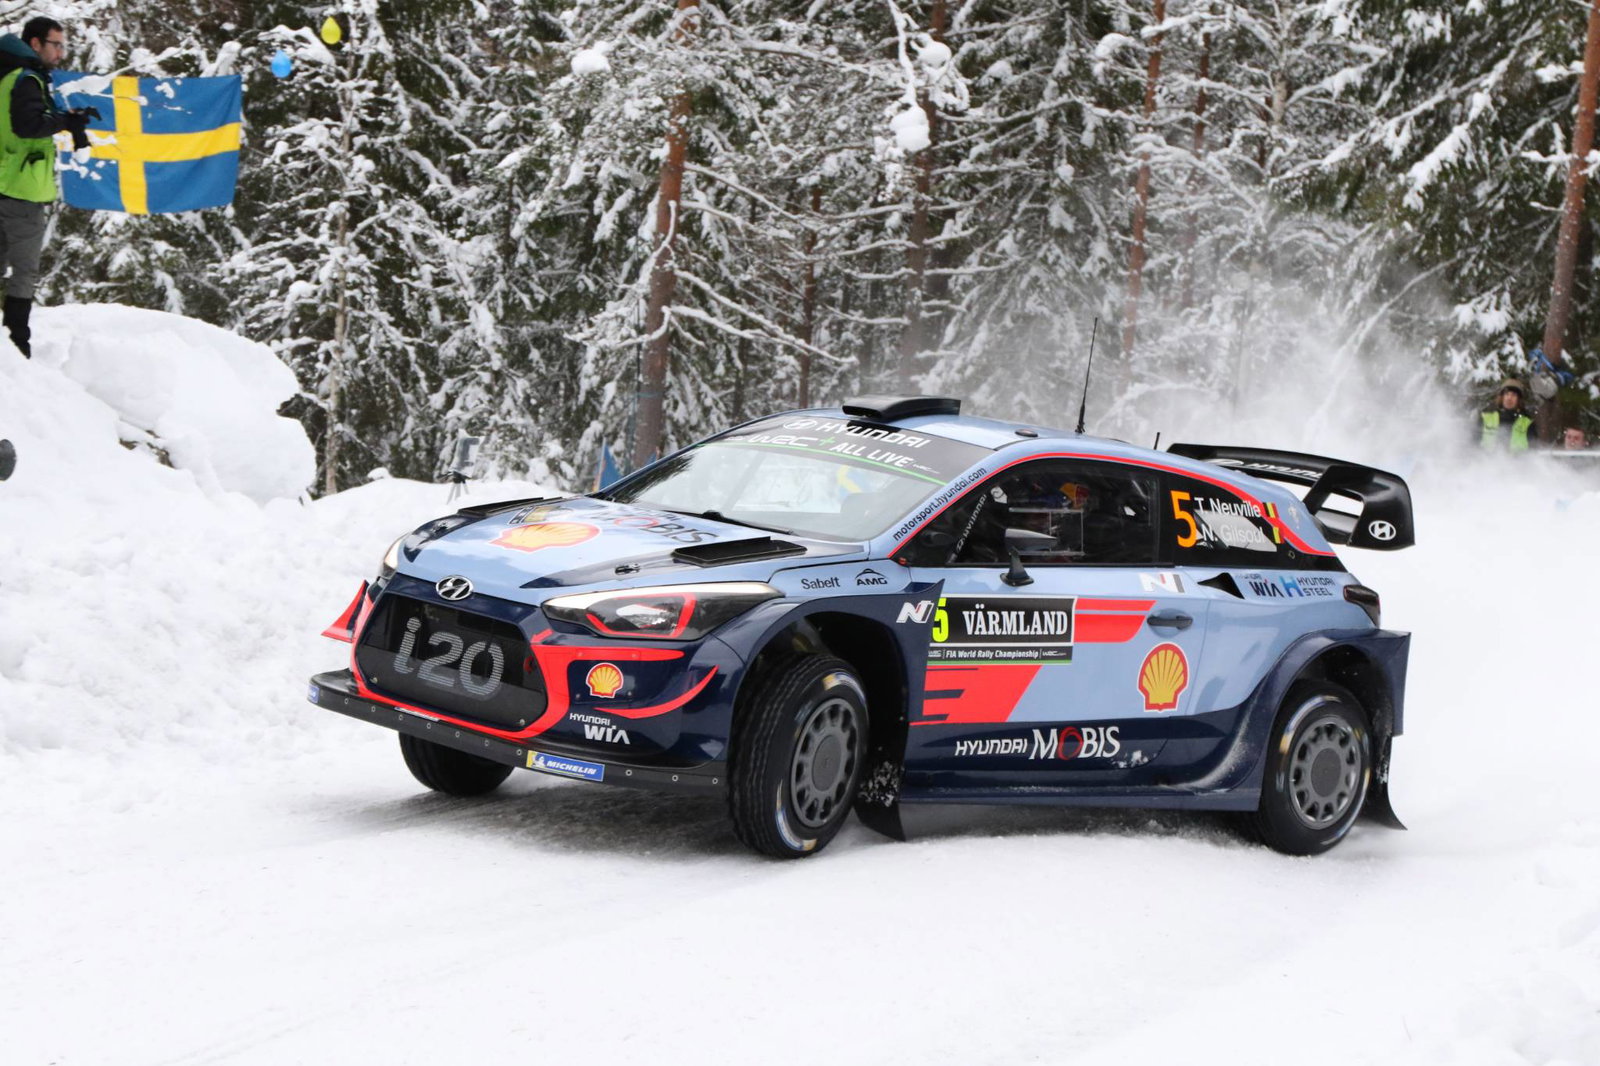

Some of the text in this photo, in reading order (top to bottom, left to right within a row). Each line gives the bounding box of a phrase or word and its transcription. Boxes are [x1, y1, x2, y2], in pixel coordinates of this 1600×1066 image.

[816, 423, 932, 449] HYUNDAI
[829, 442, 863, 457] ALL
[867, 448, 914, 468] LIVE
[893, 466, 987, 542] motorsport.hyundai.com
[1194, 497, 1262, 518] T. Neuville
[594, 513, 719, 543] OBIS
[1170, 490, 1198, 548] 5
[1202, 525, 1266, 544] N. Gilsoul
[801, 576, 841, 590] Sabelt
[856, 577, 888, 586] AMG
[1296, 577, 1336, 586] HYUNDAI
[1302, 587, 1333, 597] STEEL
[932, 597, 949, 642] 5
[962, 603, 1068, 636] VÄRMLAND
[393, 616, 504, 698] i20
[945, 649, 957, 658] FIA
[958, 649, 976, 658] World
[978, 649, 994, 660] Rally
[994, 649, 1039, 660] Championship
[569, 712, 611, 726] HYUNDAI
[584, 724, 631, 745] WIA
[955, 725, 1121, 761] HYUNDAI MOBIS
[546, 760, 598, 775] MICHELIN
